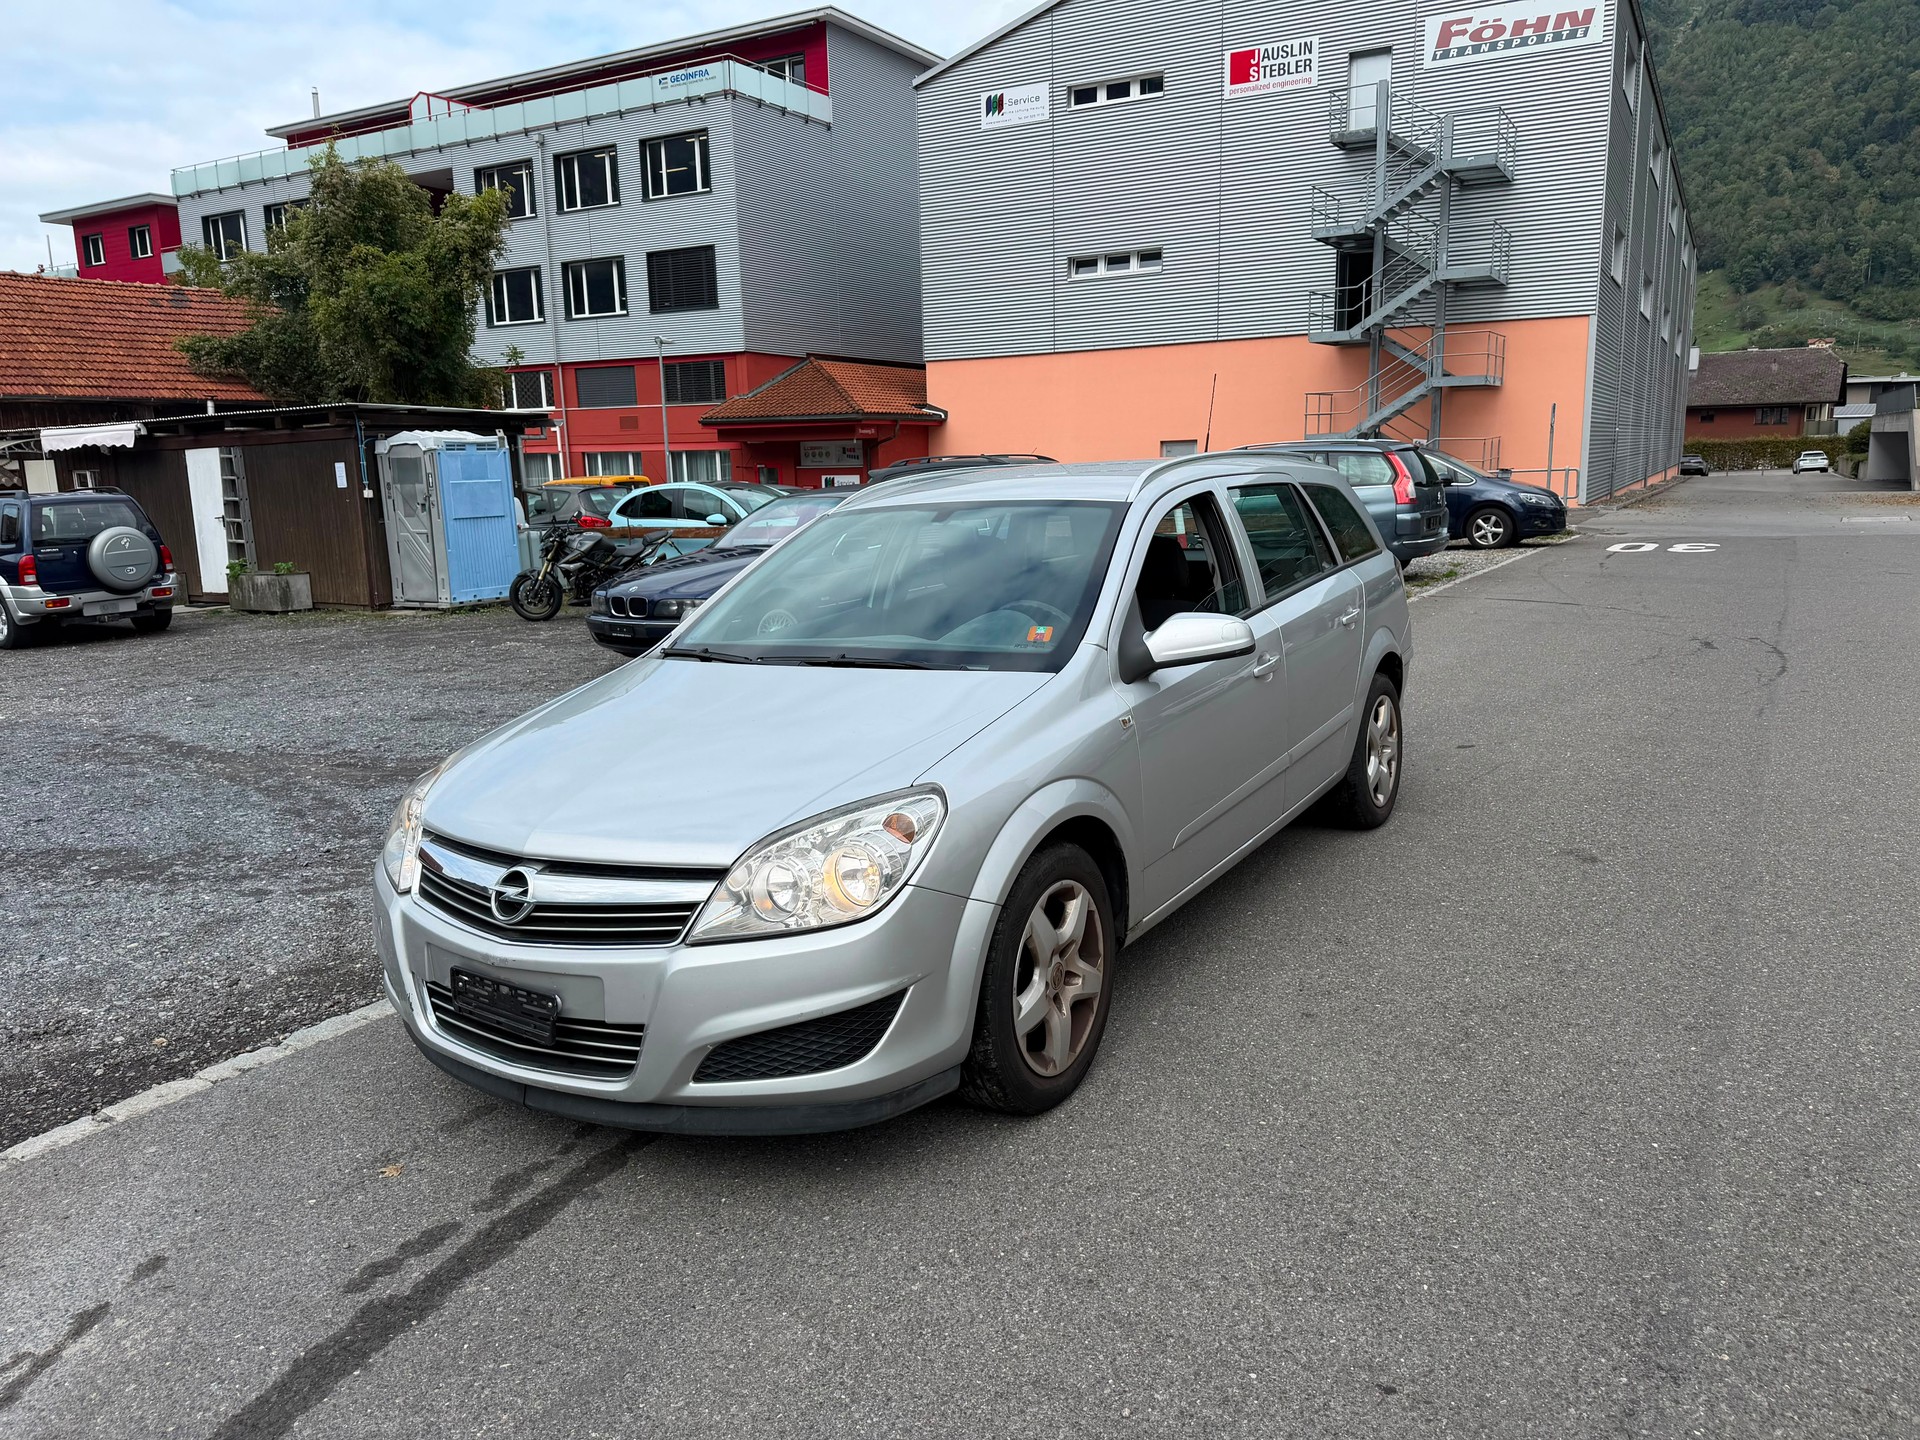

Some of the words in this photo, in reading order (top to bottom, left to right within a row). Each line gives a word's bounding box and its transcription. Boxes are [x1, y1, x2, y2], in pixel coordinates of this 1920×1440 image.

[1435, 8, 1596, 50] FÖHN
[1250, 40, 1313, 64] JAUSLIN
[1434, 28, 1587, 60] TRANSPORTE
[670, 69, 709, 83] GEOINFRA
[1249, 58, 1312, 82] STEBLER
[1229, 82, 1271, 96] personalized
[1272, 76, 1312, 89] engineering
[1605, 542, 1721, 553] 30
